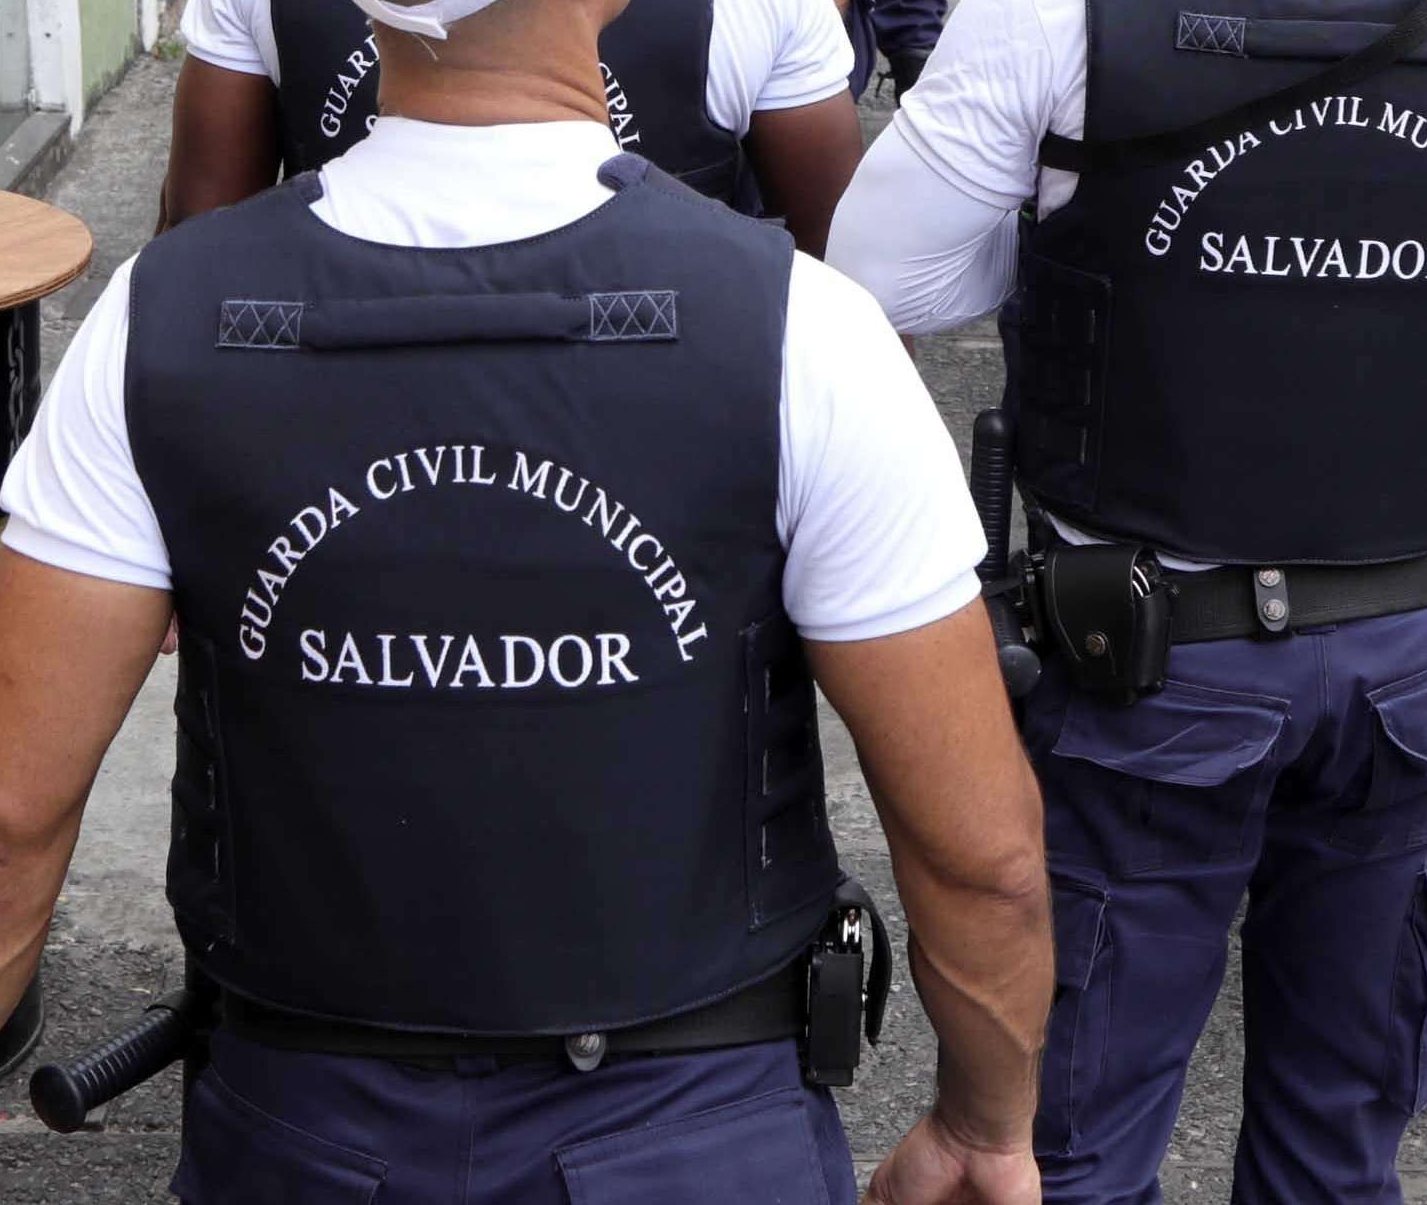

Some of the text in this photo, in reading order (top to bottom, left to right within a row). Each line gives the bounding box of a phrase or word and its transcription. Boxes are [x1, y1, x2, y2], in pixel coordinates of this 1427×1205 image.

[320, 26, 380, 138] GUAR
[598, 61, 641, 155] CIPAL
[1144, 130, 1262, 258] GUARDA
[239, 444, 709, 663] GUARDA CIVIL MUNICIPAL
[299, 628, 640, 689] SALVADOR
